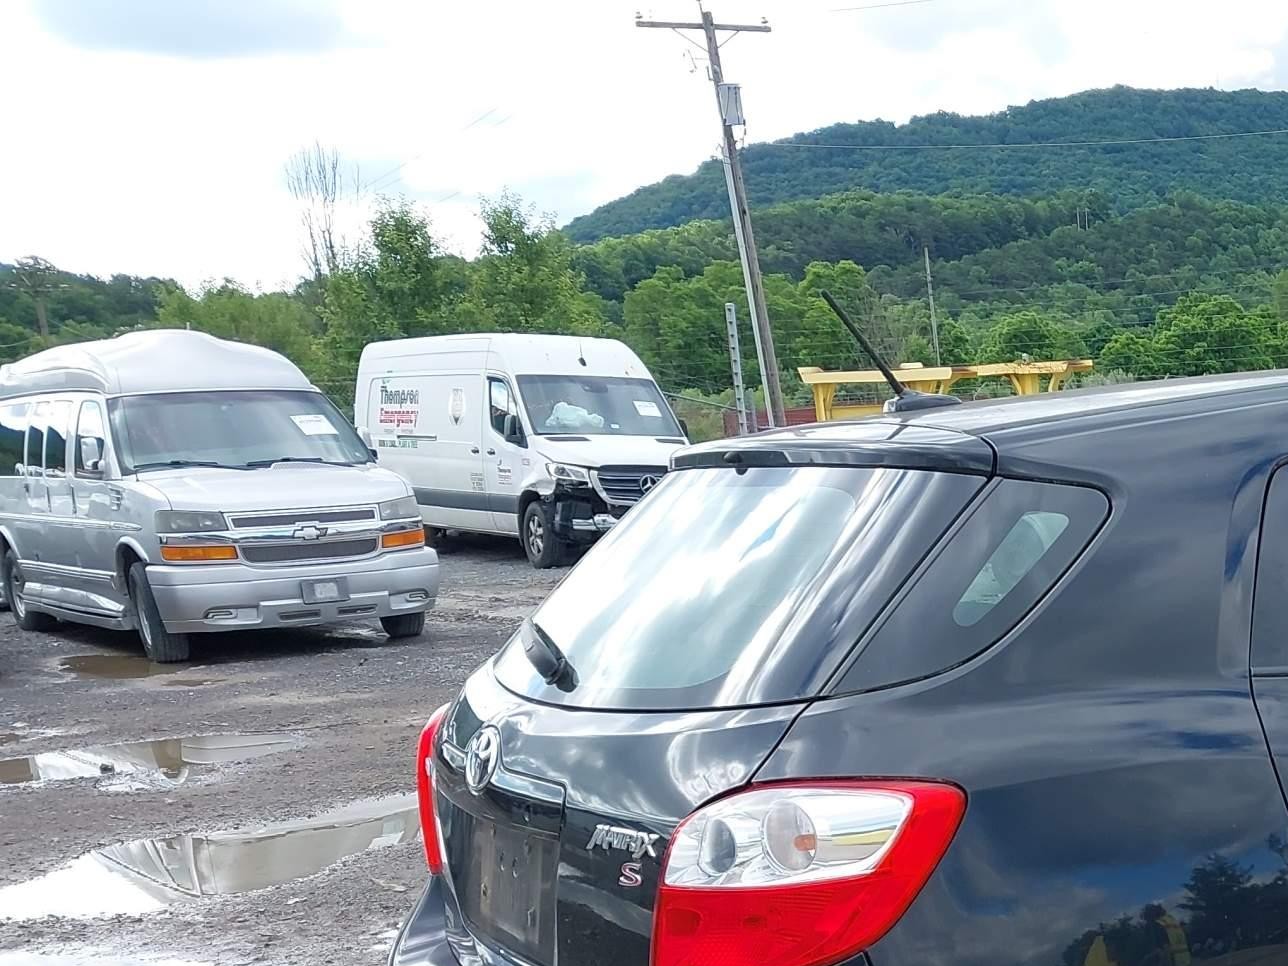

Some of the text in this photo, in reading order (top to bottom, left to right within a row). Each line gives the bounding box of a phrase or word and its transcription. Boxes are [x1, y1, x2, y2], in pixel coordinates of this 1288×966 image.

[380, 386, 419, 408] Thompson
[585, 824, 660, 859] MATRIX
[618, 862, 642, 887] S
